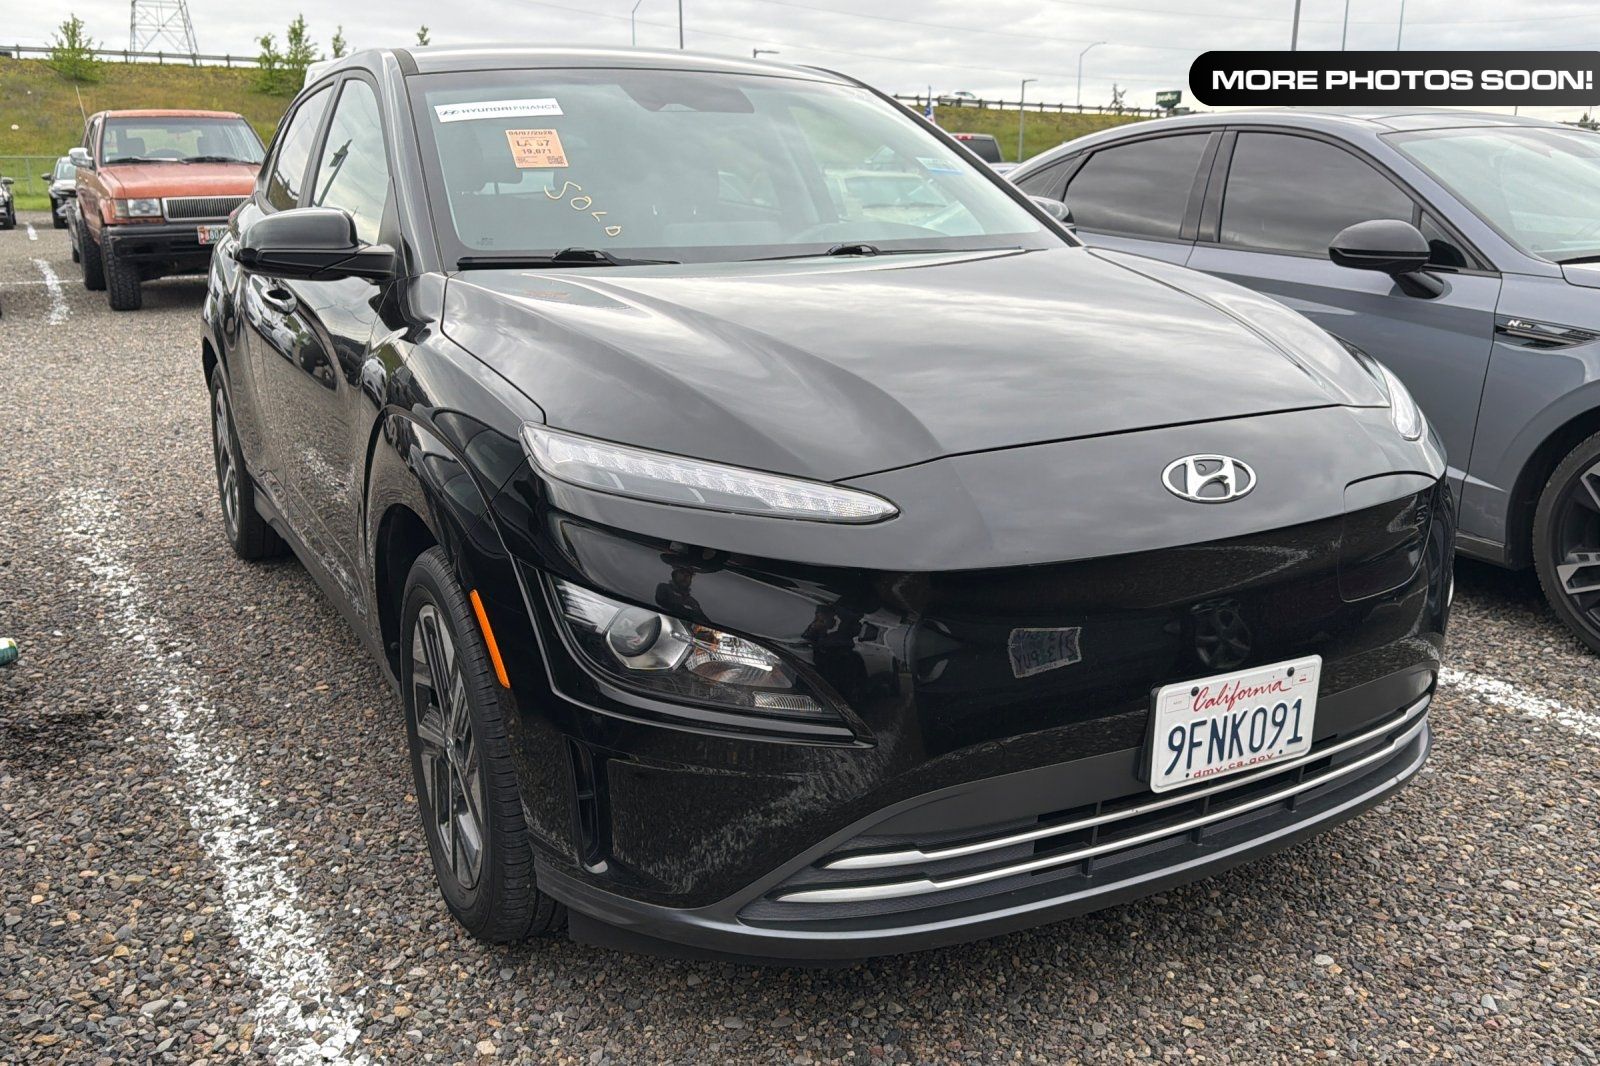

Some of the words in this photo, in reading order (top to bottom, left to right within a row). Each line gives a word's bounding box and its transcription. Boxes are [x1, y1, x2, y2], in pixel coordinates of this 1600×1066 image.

[462, 105, 512, 114] HYUNDAI
[514, 103, 559, 111] FINANCE
[543, 180, 622, 237] SOLD
[1193, 680, 1291, 711] California
[1165, 699, 1303, 775] 9FNK091
[1193, 753, 1274, 778] dmv.ca.gov
